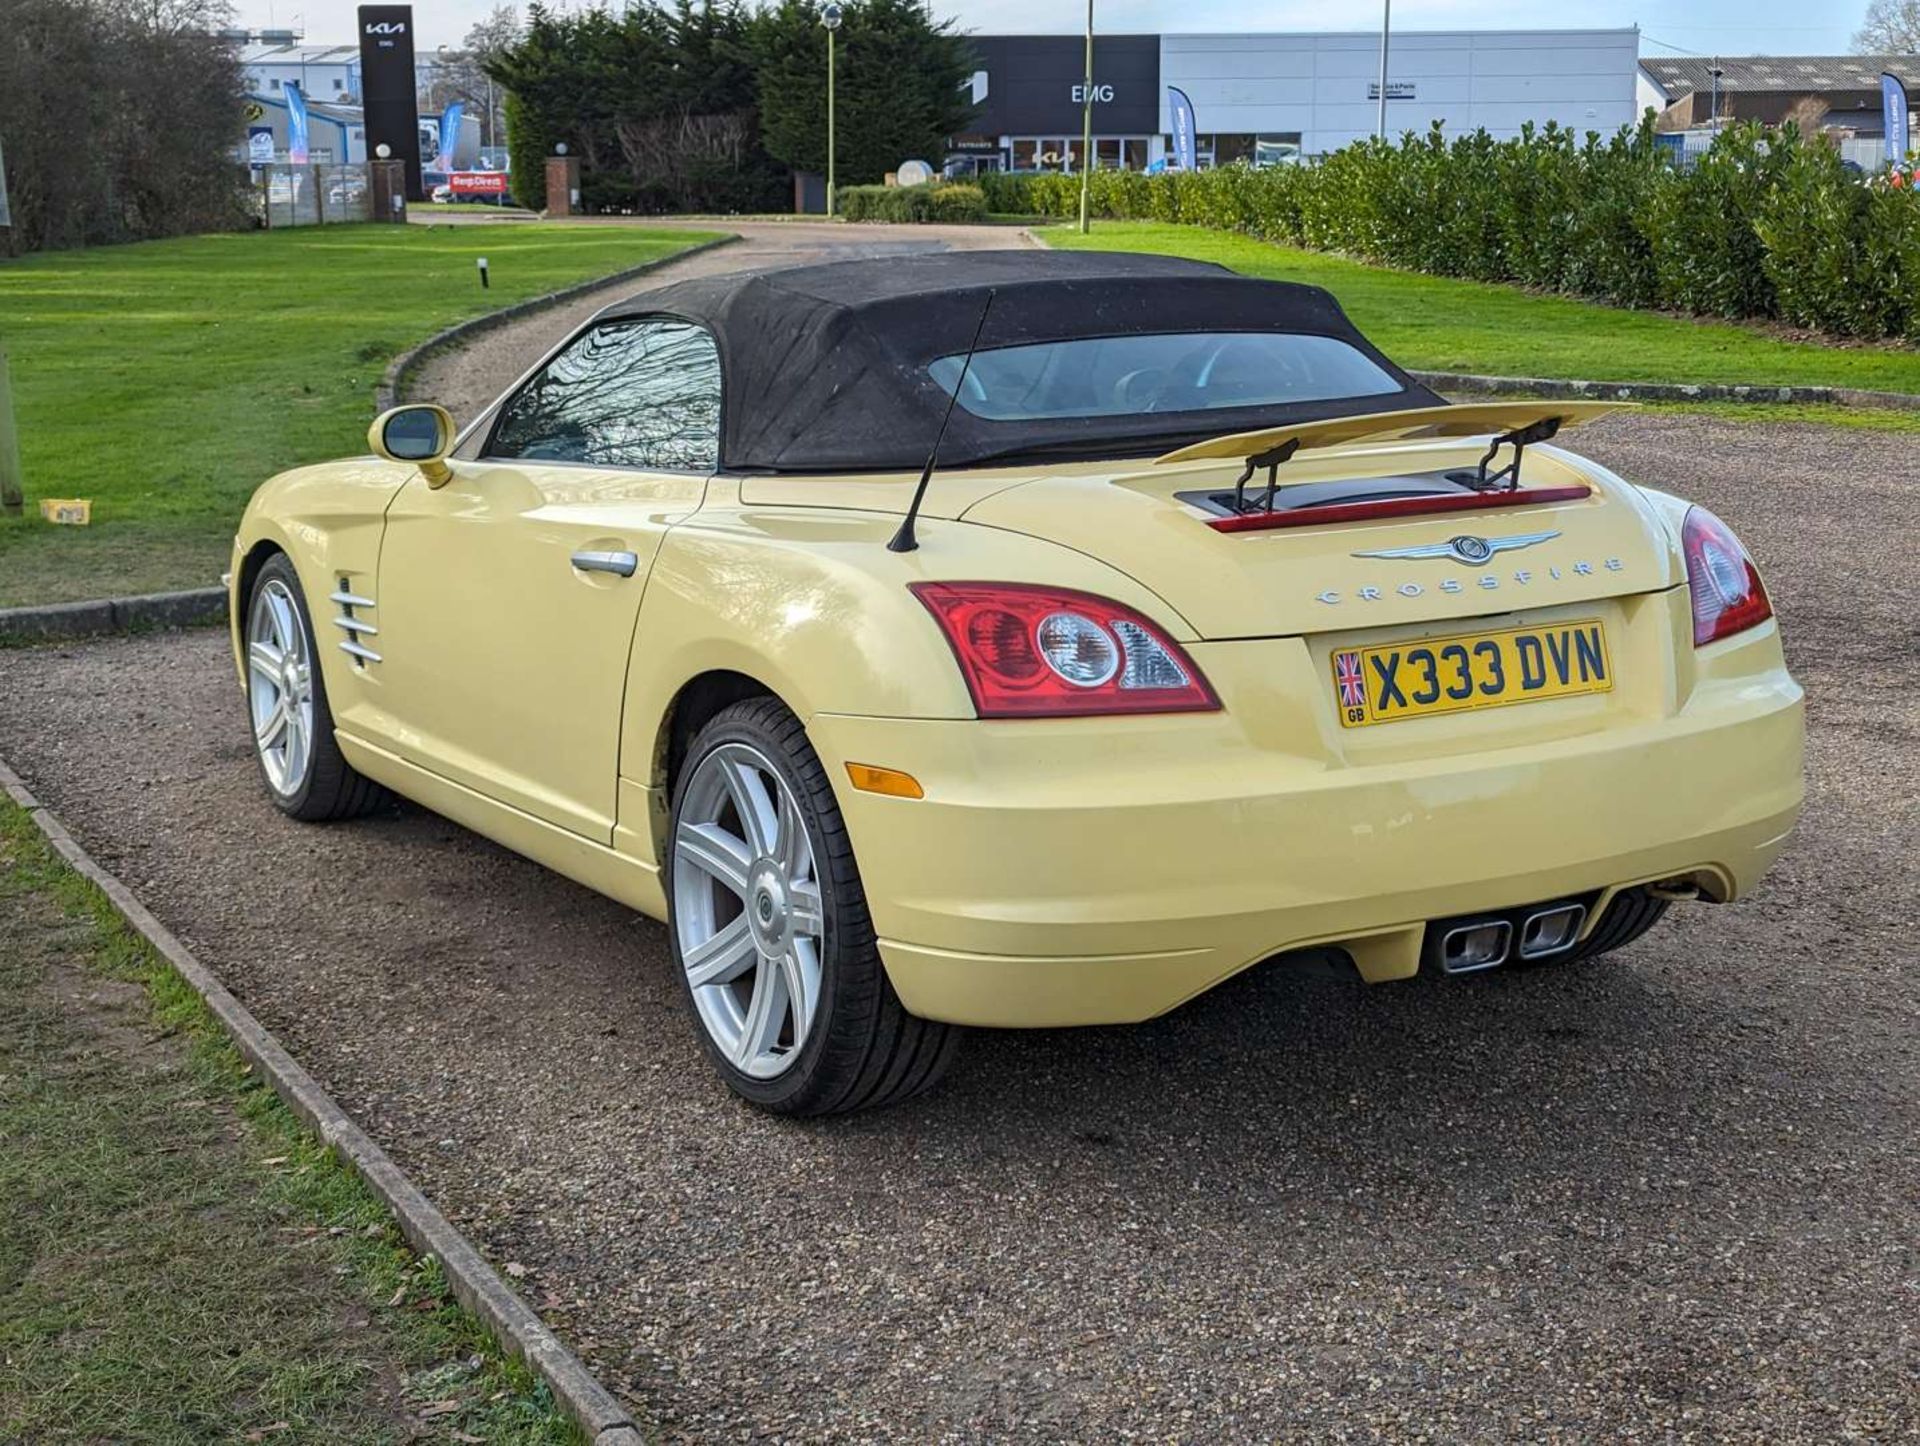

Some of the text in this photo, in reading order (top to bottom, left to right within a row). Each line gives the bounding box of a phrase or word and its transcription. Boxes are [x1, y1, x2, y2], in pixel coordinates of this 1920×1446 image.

[366, 22, 406, 34] KIA
[1071, 85, 1114, 102] EMG
[1315, 557, 1625, 604] CROSSFIRE
[1370, 627, 1606, 711] X333 DVN
[1348, 708, 1365, 723] GB
